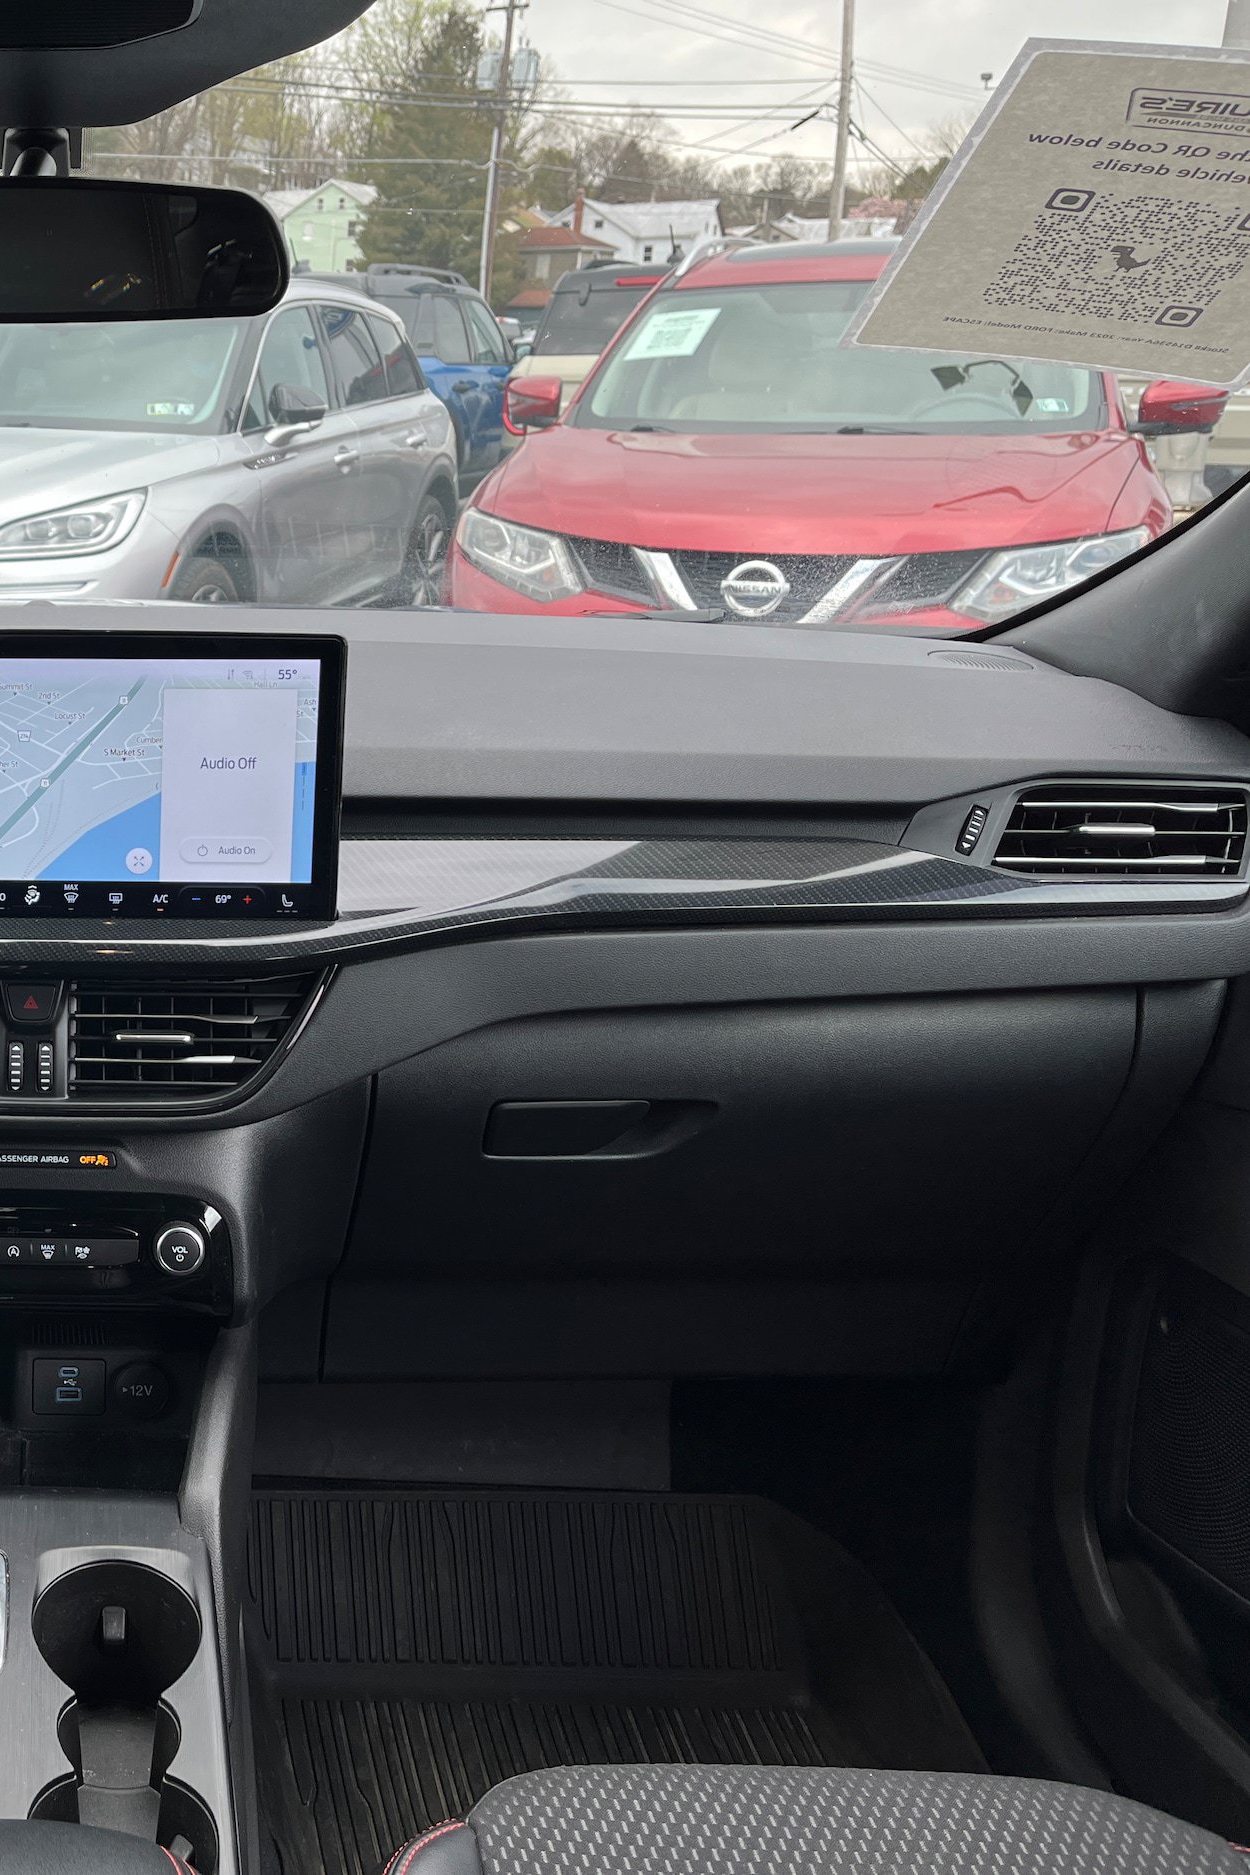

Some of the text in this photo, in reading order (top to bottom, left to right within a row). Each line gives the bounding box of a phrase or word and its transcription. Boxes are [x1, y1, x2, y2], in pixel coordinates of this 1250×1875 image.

[278, 669, 298, 680] 55°
[38, 692, 51, 700] 2nd
[54, 712, 86, 720] Locust St
[103, 749, 145, 757] S Market St
[200, 757, 257, 769] Audio Off
[218, 846, 256, 855] Audio On
[153, 894, 169, 903] A/C
[215, 894, 232, 903] 69°
[41, 1155, 69, 1163] AIRBAG
[80, 1155, 96, 1164] OFF
[171, 1246, 188, 1254] VOL
[130, 1385, 153, 1396] 12V
